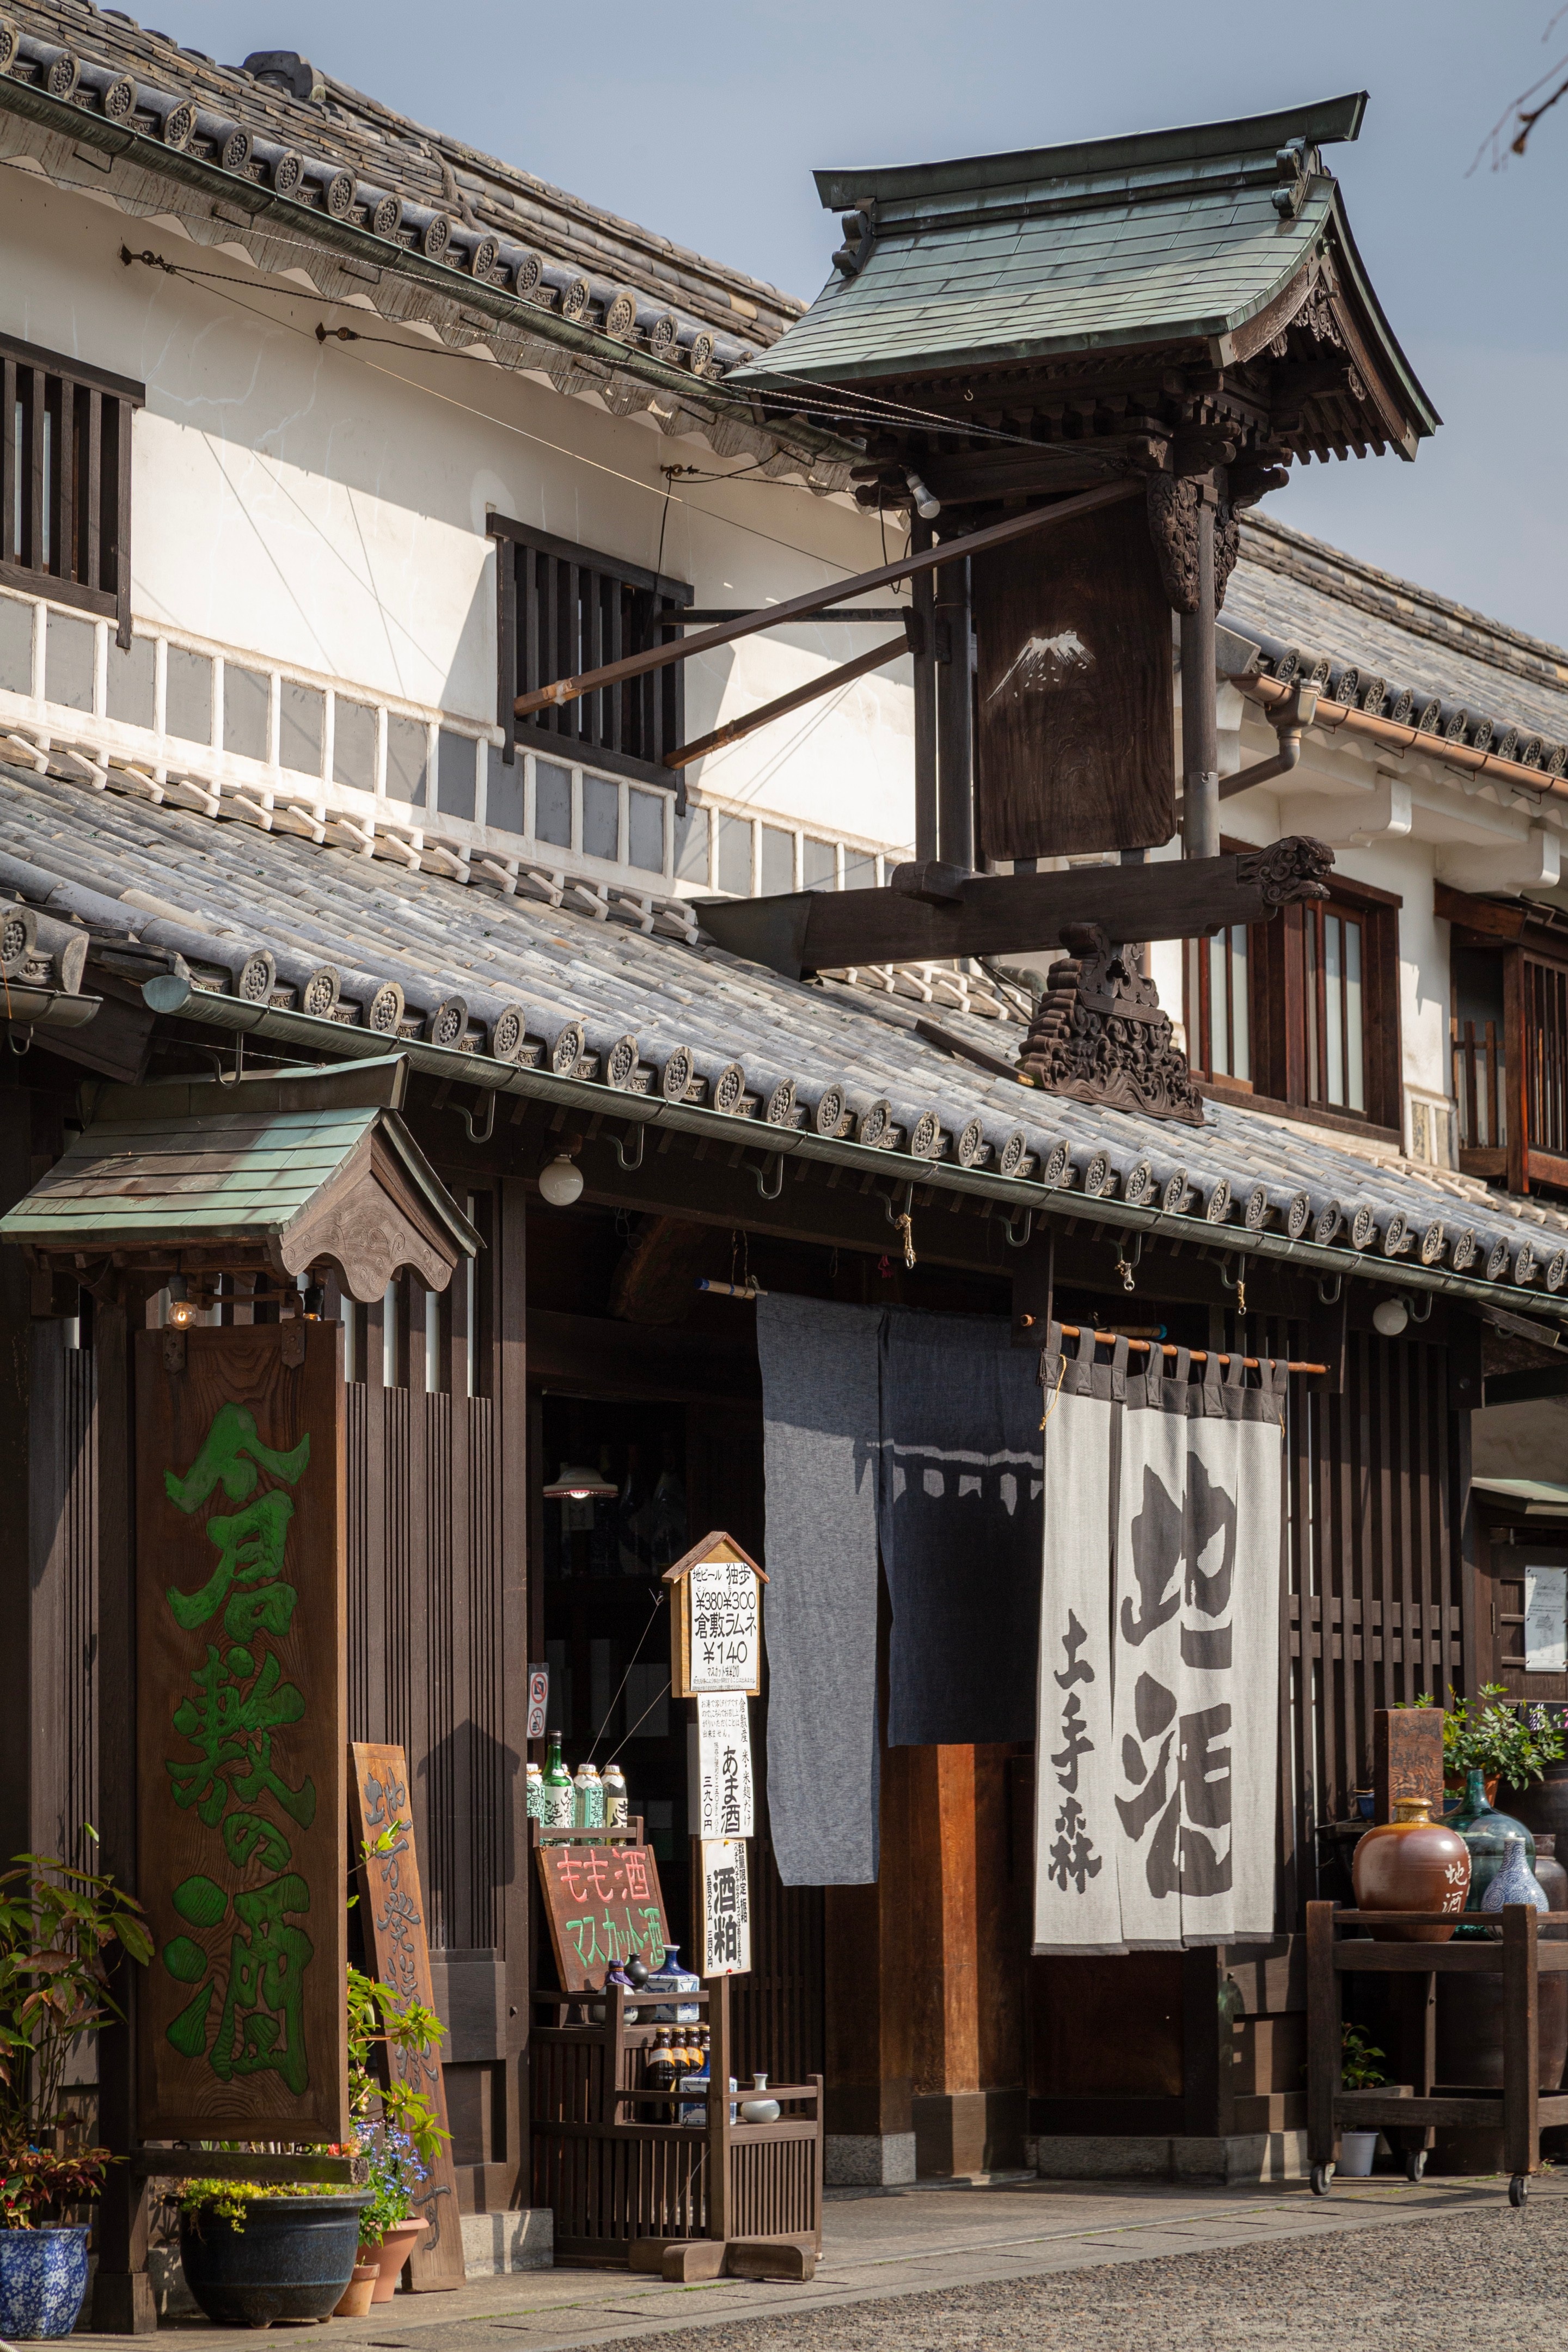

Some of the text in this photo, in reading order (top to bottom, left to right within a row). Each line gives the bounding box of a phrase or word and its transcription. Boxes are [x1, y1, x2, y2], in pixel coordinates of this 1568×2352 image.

[693, 1563, 751, 1585] 地ビール 独歩
[694, 1612, 757, 1639] 倉敷ラムネ
[703, 1641, 748, 1664] ¥140
[739, 1697, 748, 1742] 倉敷産
[163, 1401, 316, 2096] 倉敷の酒
[1048, 1608, 1103, 1896] 土手森
[703, 1776, 713, 1832] 三九〇円
[721, 1745, 741, 1834] あま酒
[557, 1848, 651, 1903] もも酒
[738, 1842, 747, 1896] 数量限定
[1442, 1861, 1465, 1913] 地酒
[566, 1907, 666, 1968] マスカット酒
[713, 1866, 737, 1964] 酒粕
